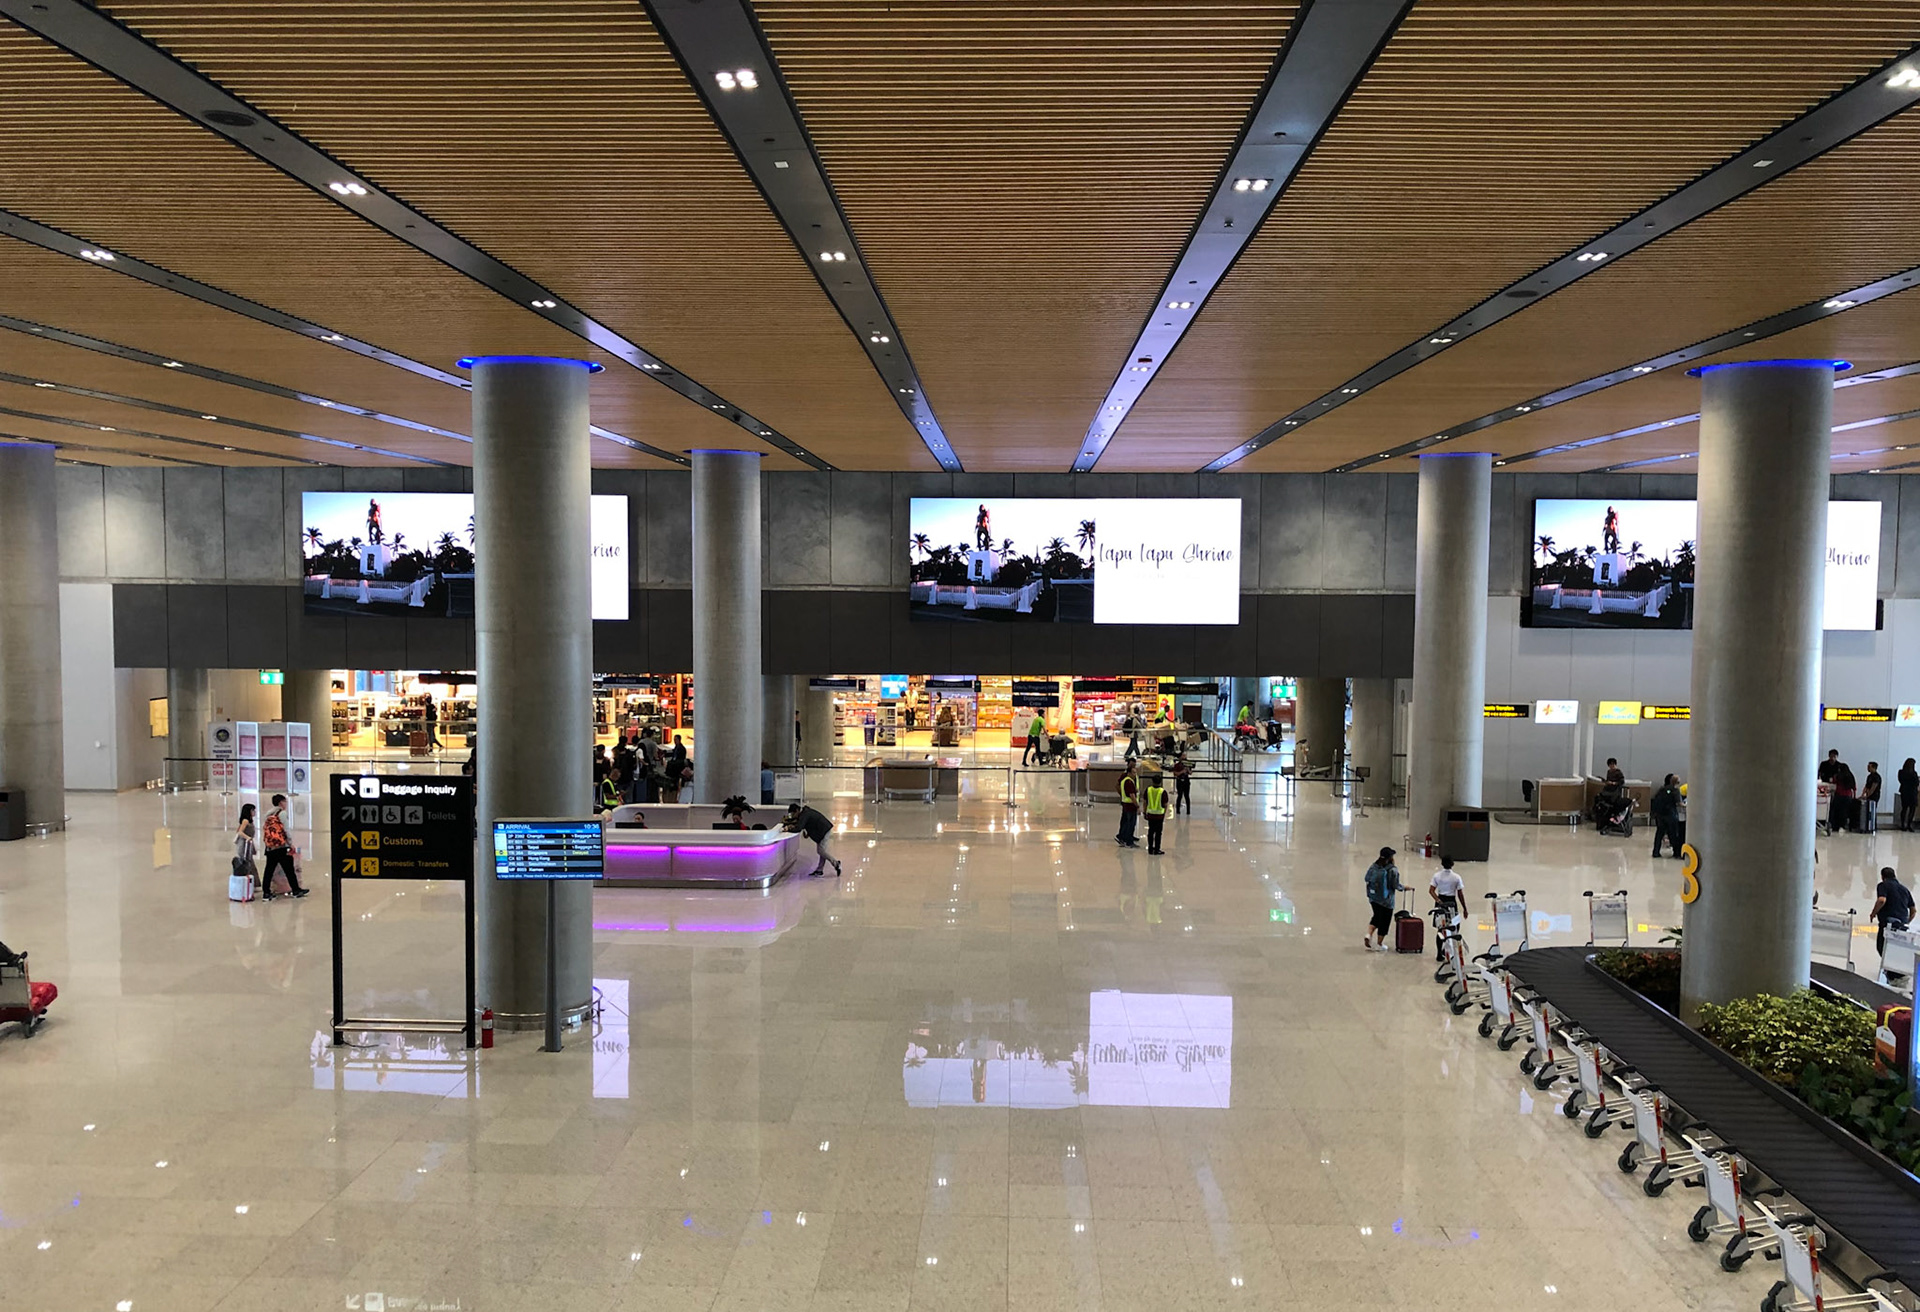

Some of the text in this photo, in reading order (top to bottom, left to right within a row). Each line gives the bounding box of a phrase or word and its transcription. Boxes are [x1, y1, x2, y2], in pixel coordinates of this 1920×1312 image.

[593, 543, 621, 558] rine
[1182, 543, 1235, 564] Shrine
[382, 783, 457, 796] Baggage Inquiry
[427, 811, 457, 820] Toilets
[382, 836, 424, 846] Customs
[382, 860, 449, 868] Domestic Transfers
[1681, 843, 1699, 904] 3
